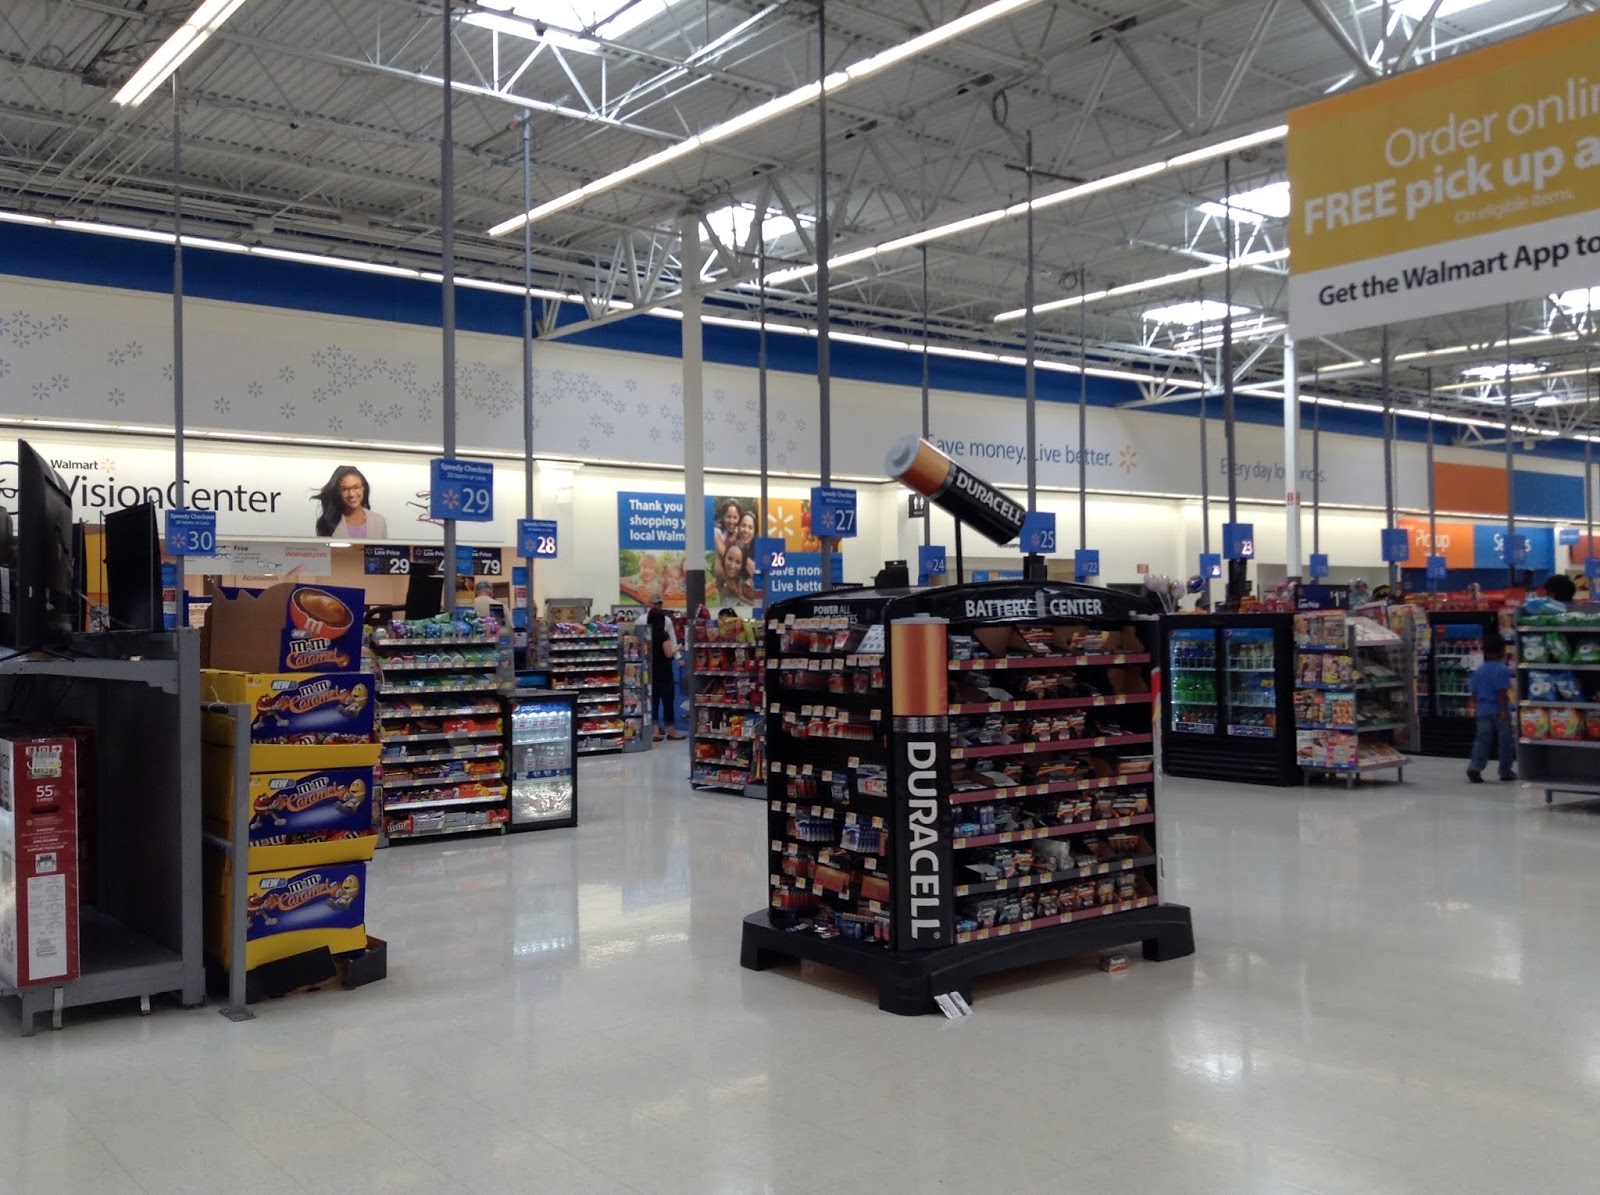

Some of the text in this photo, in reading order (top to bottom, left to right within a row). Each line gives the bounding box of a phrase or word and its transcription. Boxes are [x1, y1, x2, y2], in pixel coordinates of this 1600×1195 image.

[1385, 113, 1499, 168] Order
[1303, 178, 1397, 235] FREE
[1405, 155, 1495, 220] pick
[1502, 145, 1565, 190] up
[1319, 235, 1600, 306] Get the Walmart App to
[970, 442, 1026, 465] money.
[51, 459, 98, 470] Walmart
[464, 465, 492, 474] Checkout
[461, 487, 490, 513] 29
[629, 499, 683, 514] Thank you
[955, 472, 1022, 526] DURACELL
[629, 514, 678, 529] shopping
[835, 510, 854, 531] 27
[188, 531, 213, 550] 30
[630, 529, 655, 541] local
[1041, 530, 1055, 549] 25
[537, 536, 555, 554] 28
[389, 558, 410, 574] 29
[481, 560, 500, 574] 79
[770, 552, 785, 567] 26
[933, 559, 945, 572] 24
[771, 580, 794, 592] Live
[813, 605, 851, 614] POWER ALL
[965, 599, 1103, 617] BATTERY CENTER
[286, 648, 338, 669] Caramel
[272, 680, 291, 690] NEW
[289, 685, 340, 713] Caramel
[269, 779, 288, 789] NEW
[286, 781, 337, 812] Caramel
[907, 741, 940, 939] DURACELL
[260, 878, 280, 889] NEW
[277, 878, 329, 911] Caramel
